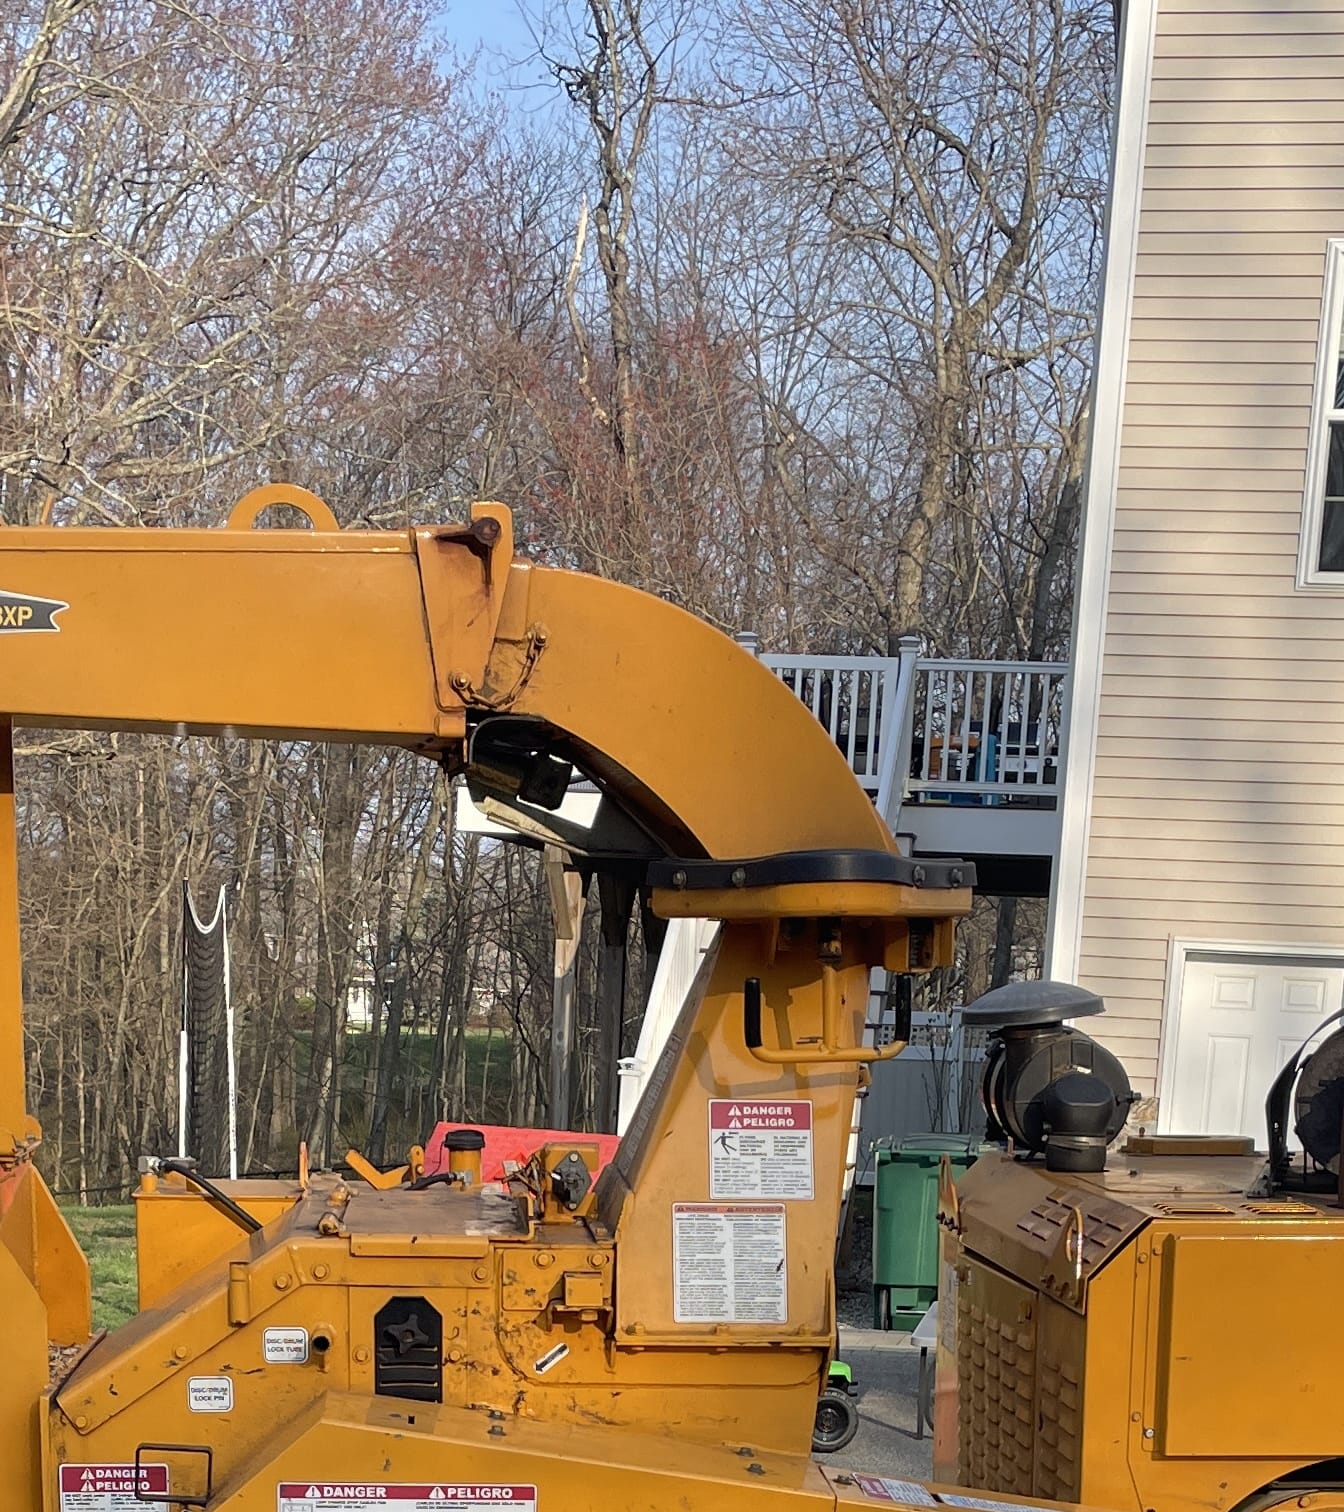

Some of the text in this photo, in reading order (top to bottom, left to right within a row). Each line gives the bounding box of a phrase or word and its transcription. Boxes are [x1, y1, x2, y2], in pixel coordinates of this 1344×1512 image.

[742, 1106, 792, 1116] DANGER
[742, 1117, 795, 1127] PELIGRO
[323, 1486, 387, 1498] DANGER
[447, 1487, 513, 1499] PELIGRO
